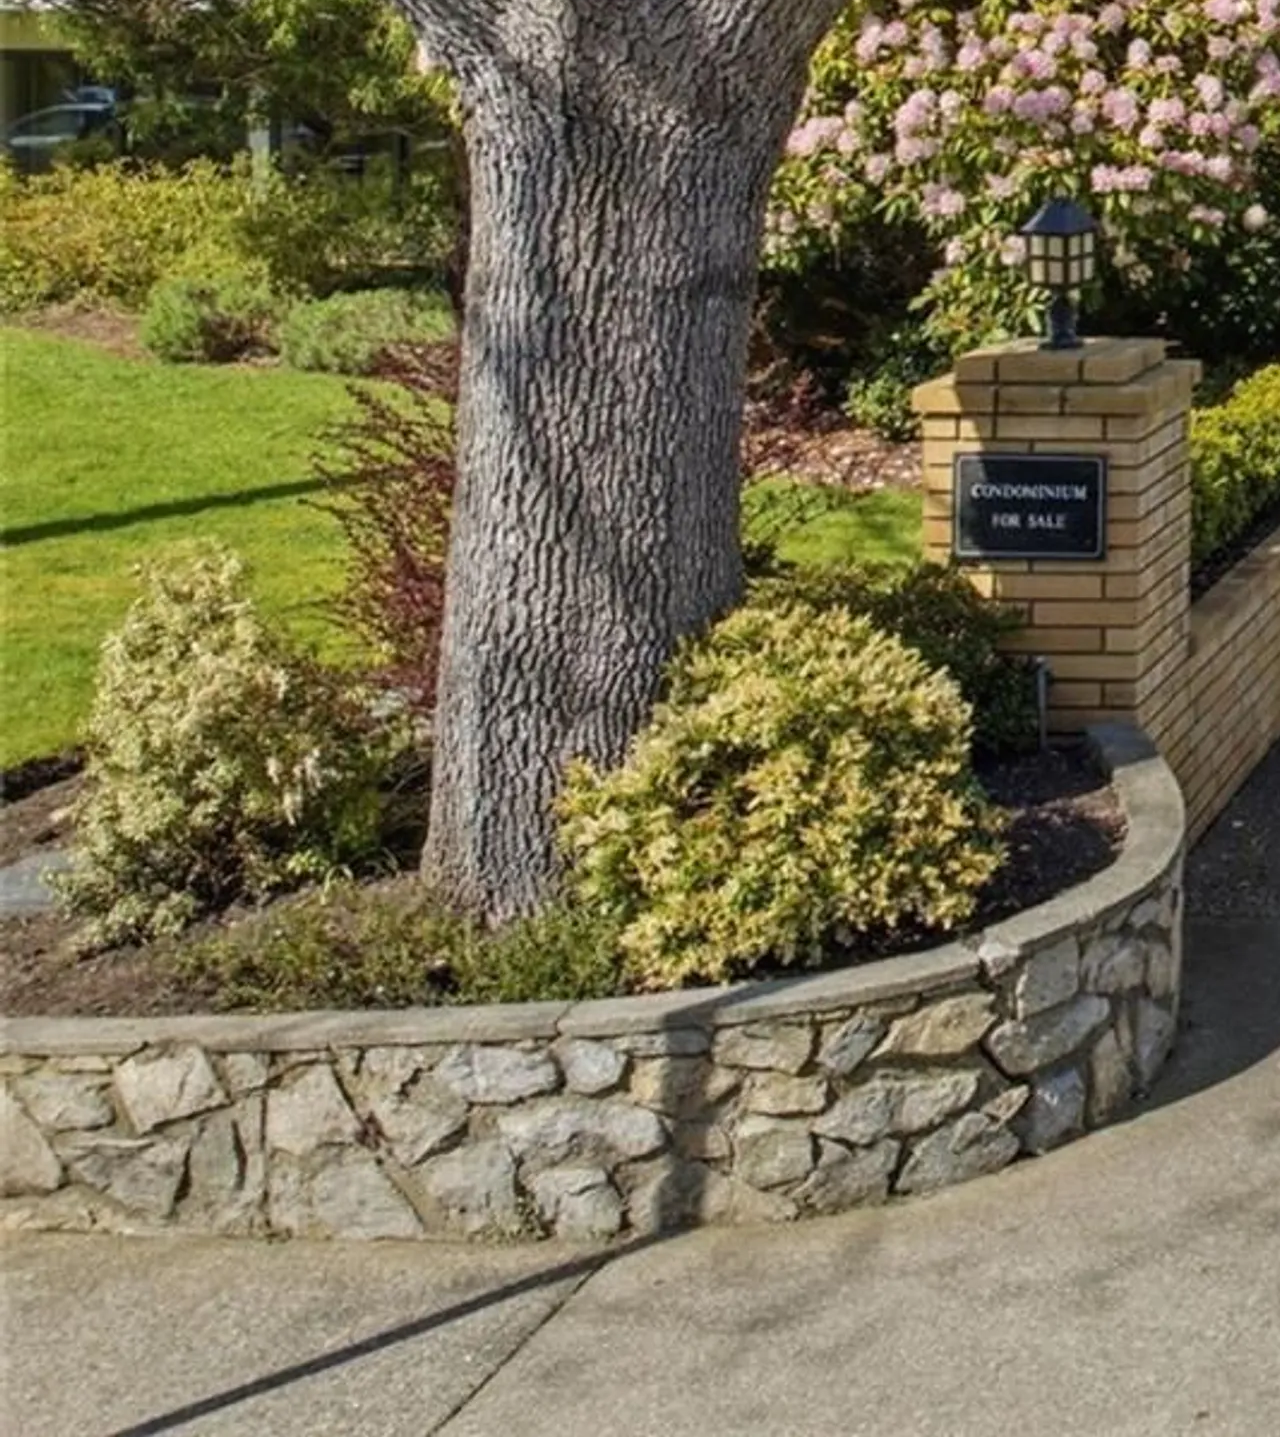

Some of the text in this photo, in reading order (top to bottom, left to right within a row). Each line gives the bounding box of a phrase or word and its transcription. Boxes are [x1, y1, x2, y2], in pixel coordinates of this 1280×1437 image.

[970, 482, 1087, 500] CONDOMINIUM
[991, 512, 1066, 529] FOR SALE
